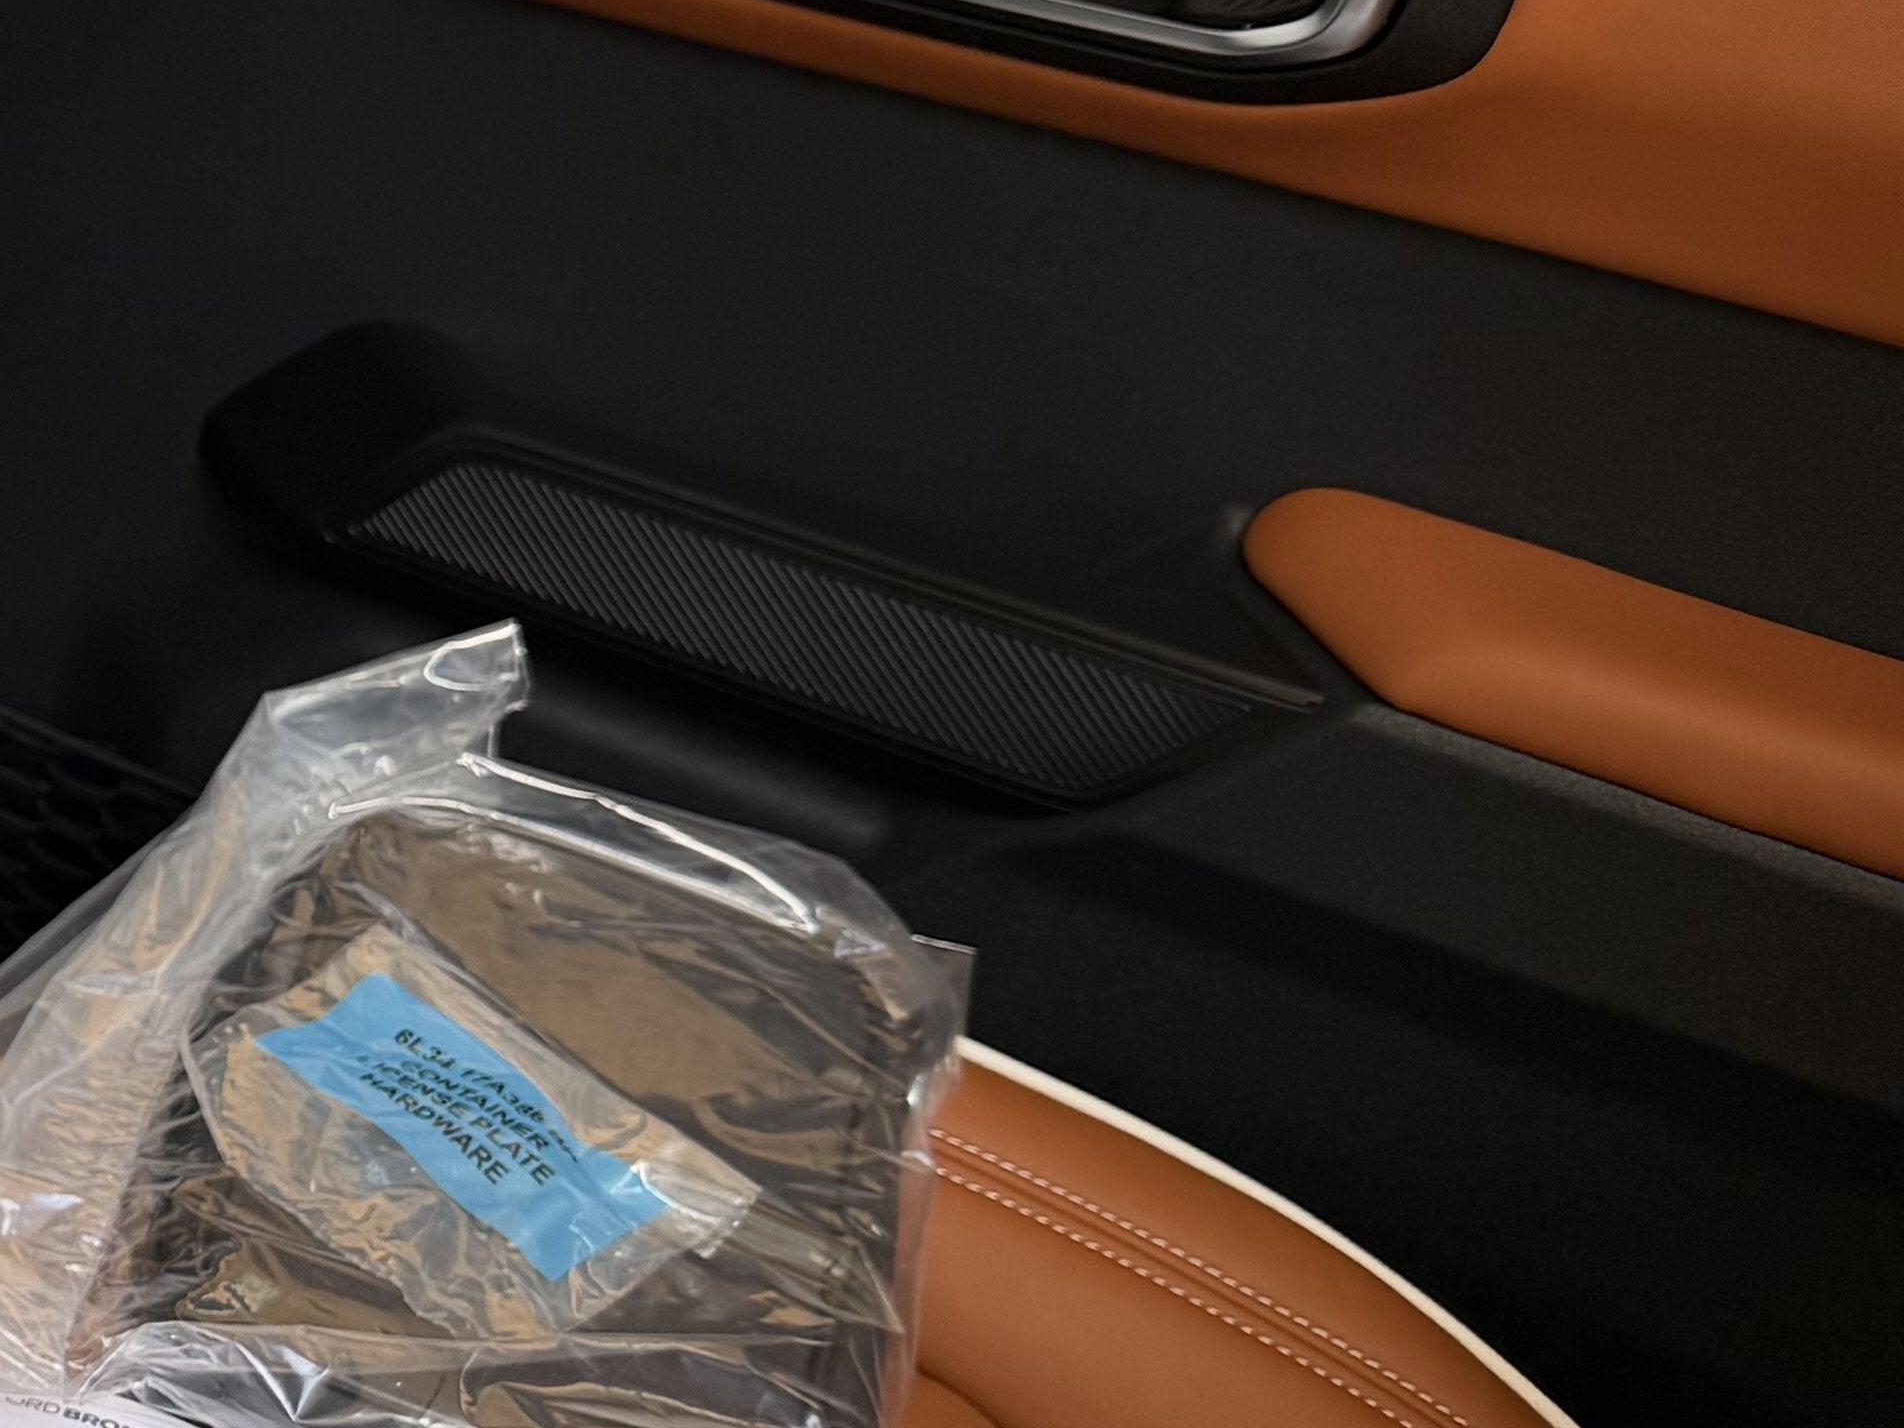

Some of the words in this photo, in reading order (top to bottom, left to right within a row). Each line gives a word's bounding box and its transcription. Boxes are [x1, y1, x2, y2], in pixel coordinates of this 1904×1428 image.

[360, 1072, 510, 1185] HARDWARE
[400, 1061, 549, 1150] CONTAINER
[470, 1116, 556, 1186] PLATE
[4, 1397, 60, 1415] ORD
